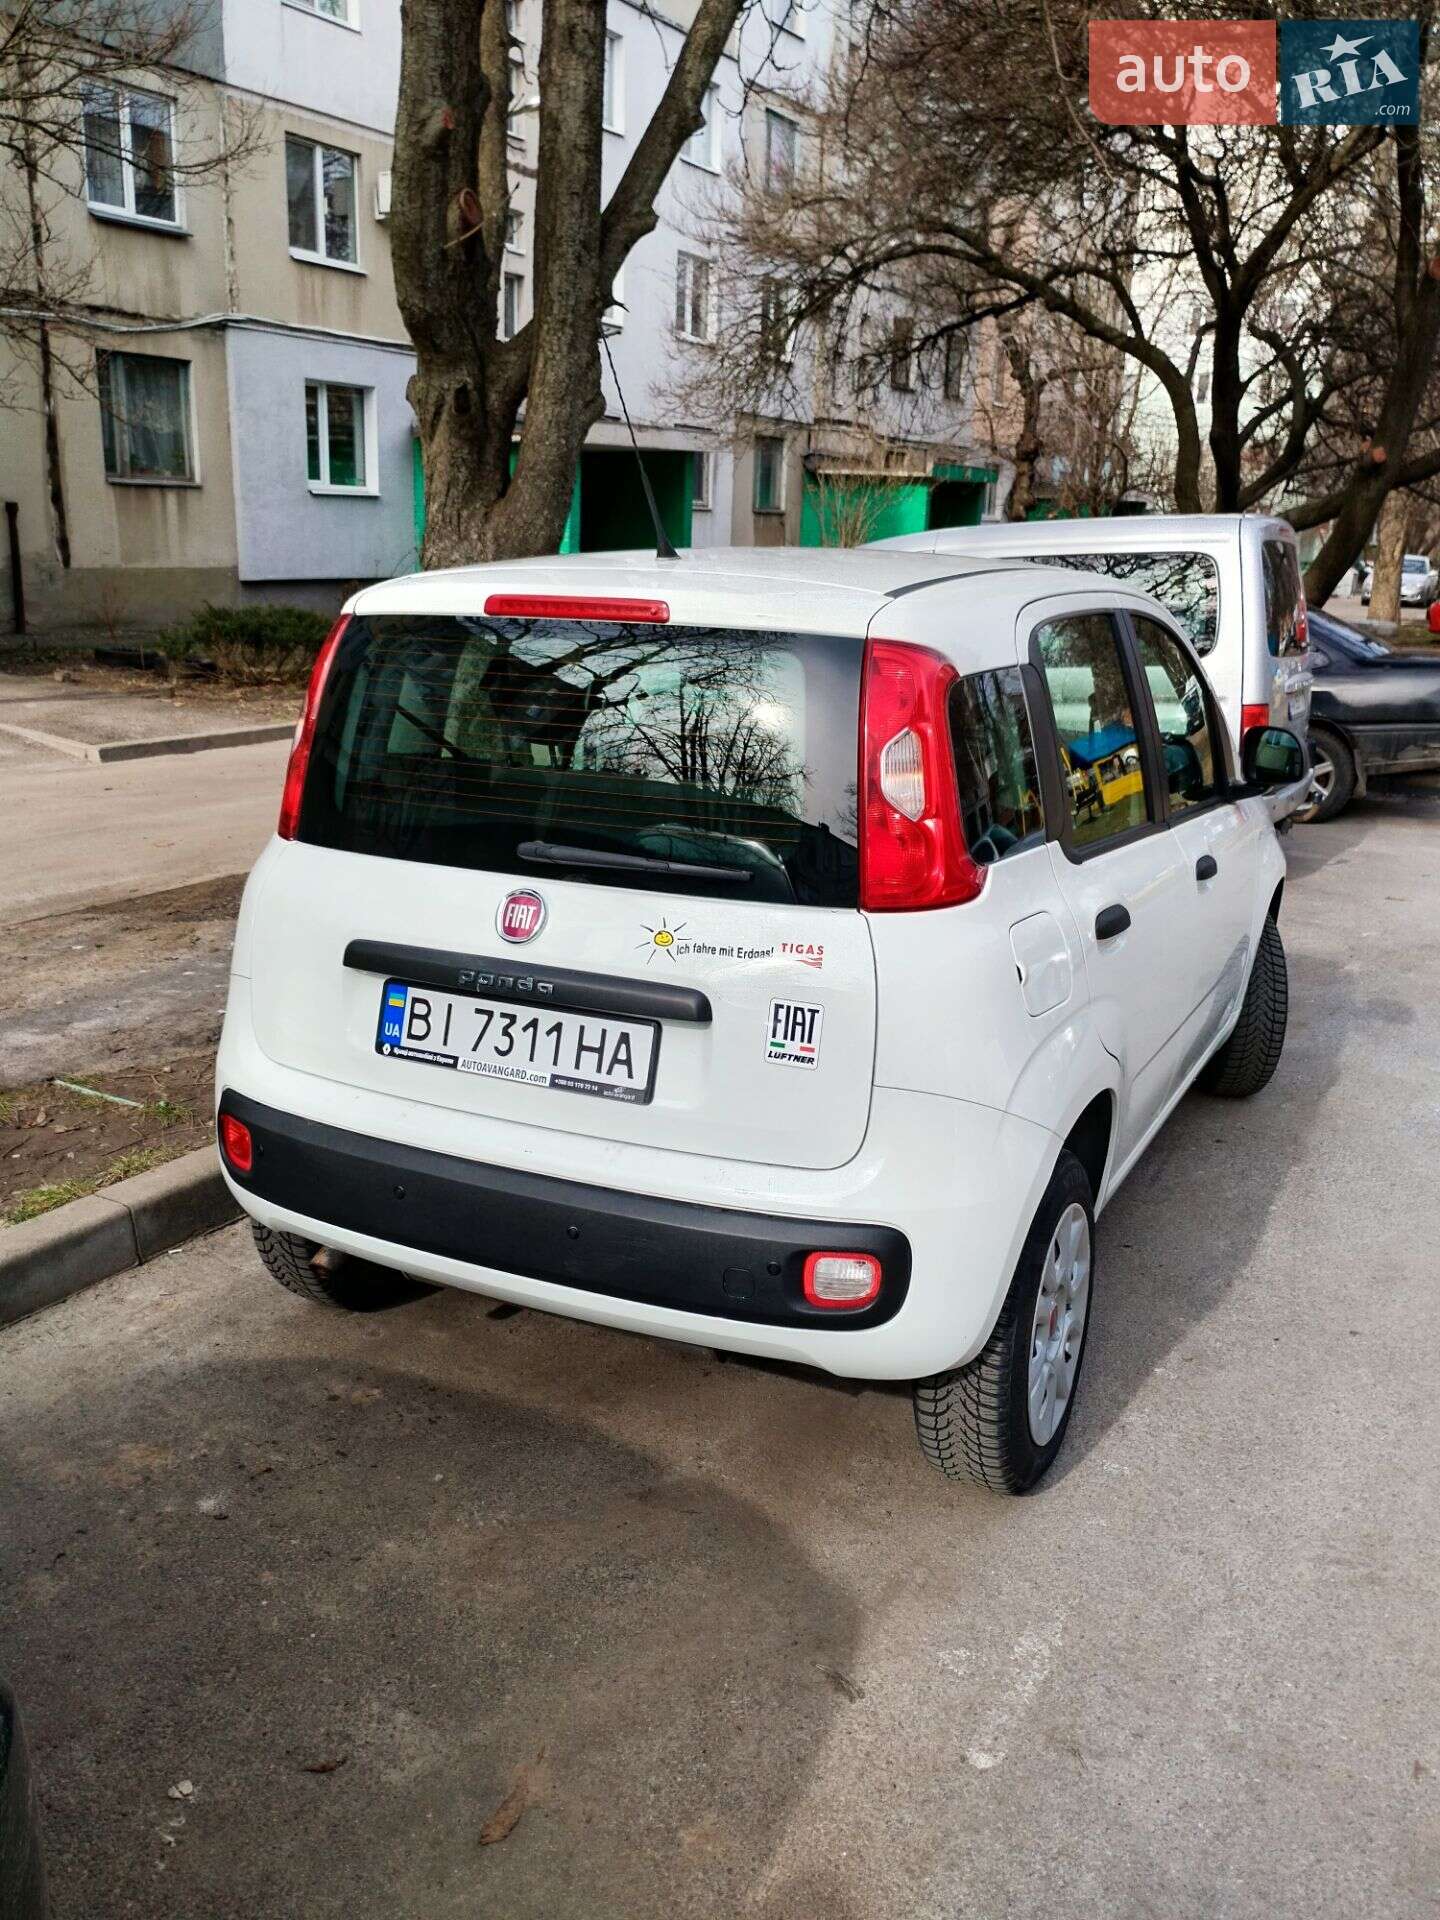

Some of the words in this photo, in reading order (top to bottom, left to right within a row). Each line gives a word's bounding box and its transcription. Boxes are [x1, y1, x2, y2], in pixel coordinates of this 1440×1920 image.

[504, 903, 537, 930] FIAT
[676, 944, 690, 956] Ich
[693, 942, 717, 955] fahre
[719, 945, 735, 958] mit
[781, 942, 825, 956] TIGAS
[384, 1021, 400, 1038] UA
[771, 1003, 820, 1045] FIAT
[406, 996, 453, 1047] BI
[471, 1007, 563, 1067] 7311
[574, 1024, 635, 1080] HA
[460, 1059, 548, 1085] AUTOAVANGARD.com
